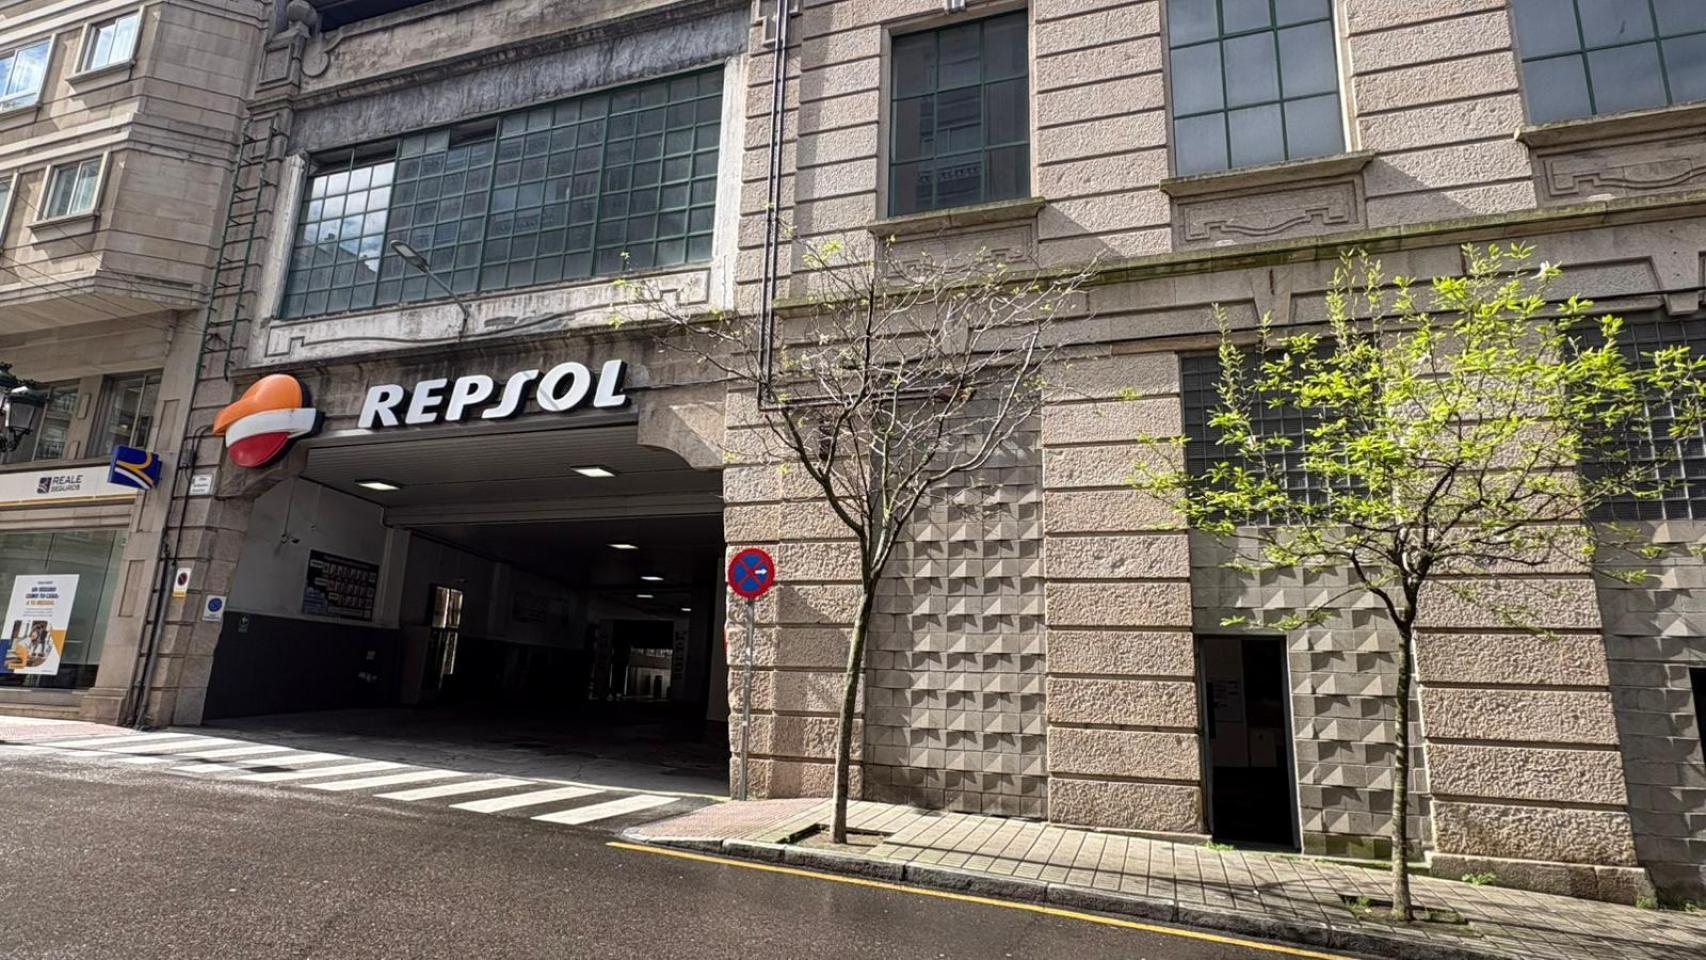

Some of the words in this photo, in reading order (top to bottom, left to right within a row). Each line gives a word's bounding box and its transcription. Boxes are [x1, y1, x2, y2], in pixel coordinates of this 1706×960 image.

[357, 359, 627, 428] REPSOL
[52, 474, 83, 485] REALE
[51, 484, 80, 492] SEGUROS
